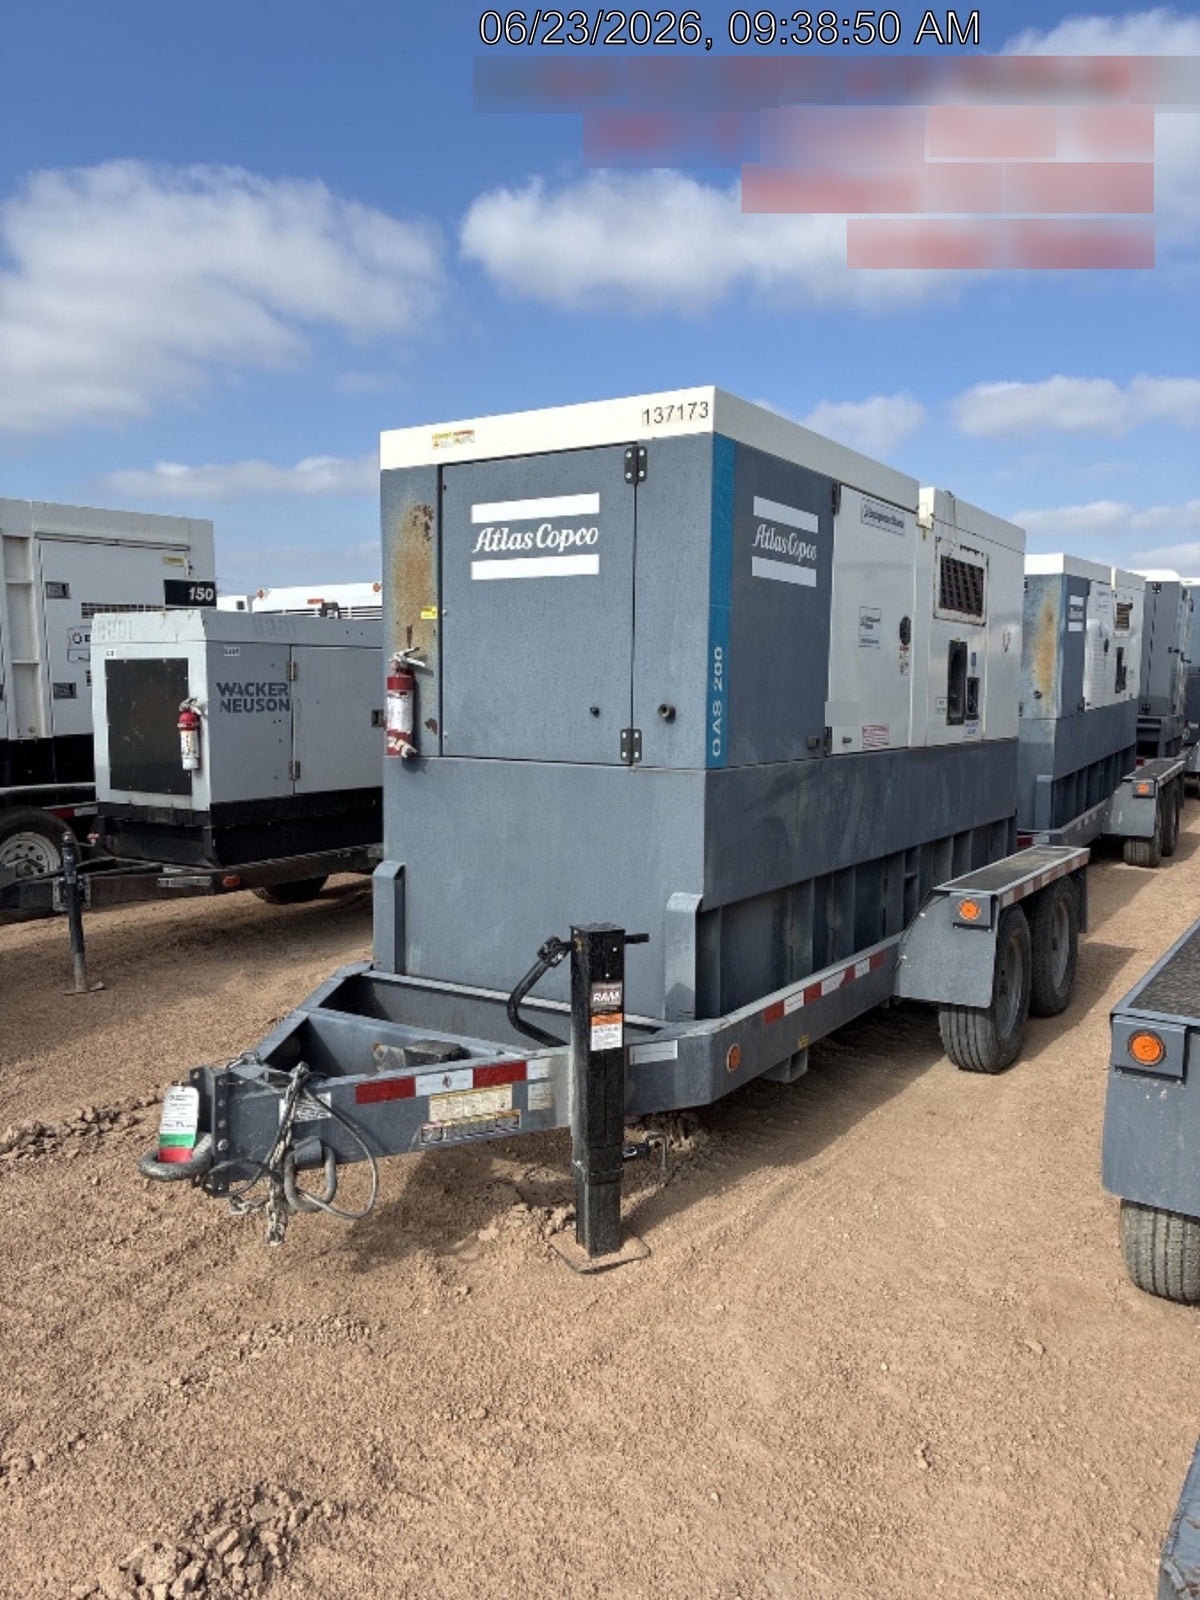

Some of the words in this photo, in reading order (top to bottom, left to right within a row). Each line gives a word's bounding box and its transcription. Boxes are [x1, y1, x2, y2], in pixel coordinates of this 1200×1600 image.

[642, 401, 709, 426] 137173
[472, 527, 534, 554] Atlas
[536, 522, 599, 552] Copco
[752, 524, 788, 553] Atlas
[787, 532, 817, 563] Copco
[188, 586, 214, 602] 150
[714, 646, 723, 691] 200
[216, 681, 289, 698] WACKER
[220, 698, 291, 714] NEUSON
[593, 991, 620, 1002] RAM
